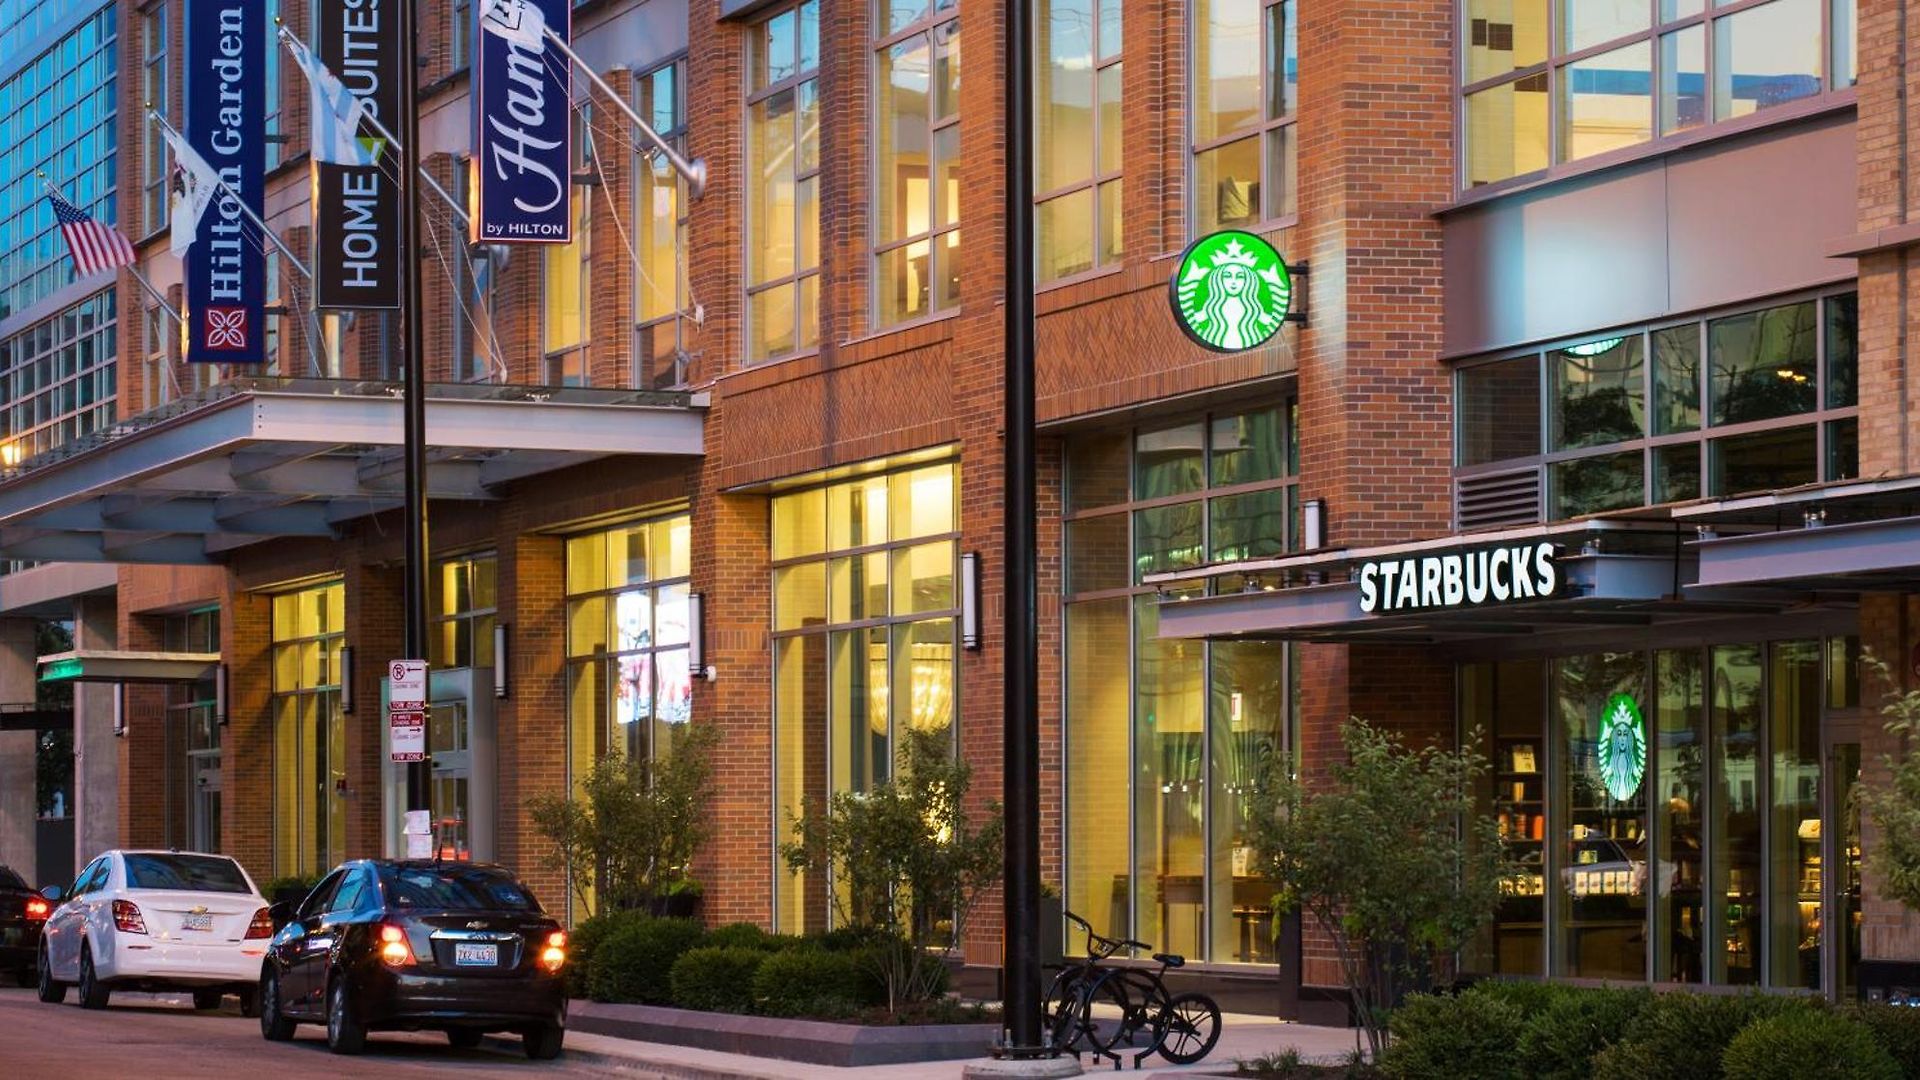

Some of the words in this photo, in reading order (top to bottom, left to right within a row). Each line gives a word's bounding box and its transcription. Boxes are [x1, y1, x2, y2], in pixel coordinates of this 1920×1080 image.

[211, 7, 242, 155] Garden
[488, 32, 562, 213] Ham
[211, 164, 242, 301] Hilton
[486, 223, 504, 235] by
[508, 223, 563, 235] HILTON
[1360, 542, 1556, 613] STARBUCKS
